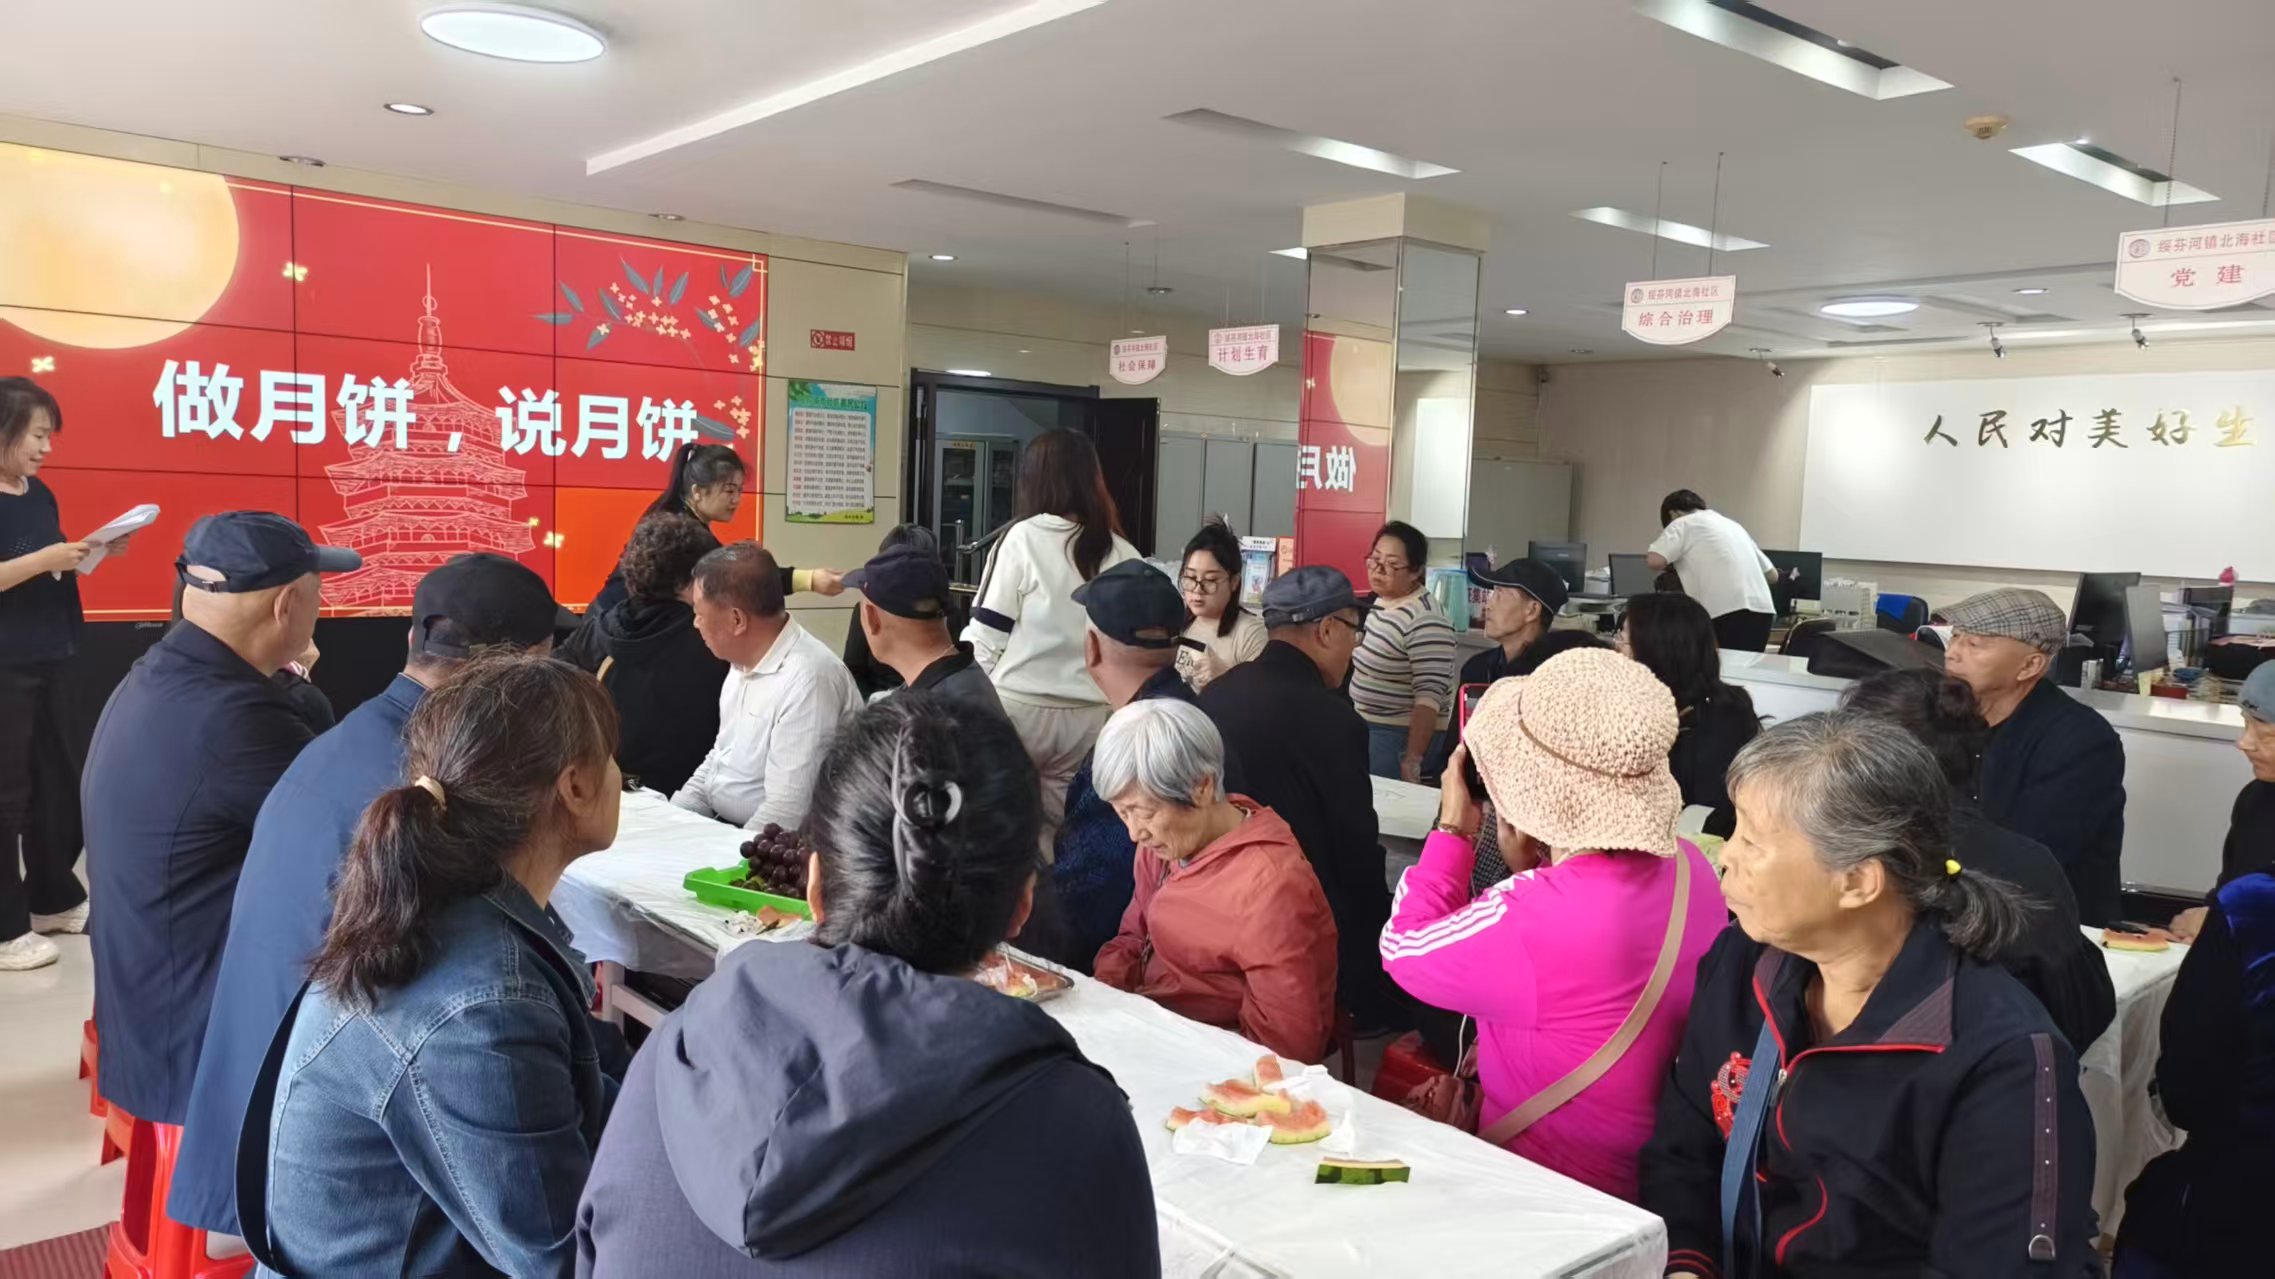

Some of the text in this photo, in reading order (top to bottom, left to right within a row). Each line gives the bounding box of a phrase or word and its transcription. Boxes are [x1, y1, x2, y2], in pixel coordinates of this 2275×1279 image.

[1638, 308, 1714, 327] 综合治理
[1217, 344, 1269, 362] 计划生育
[1119, 359, 1156, 372] 社会保障
[152, 359, 699, 463] 做月饼，说月饼
[1923, 405, 2254, 449] 人民对美好生
